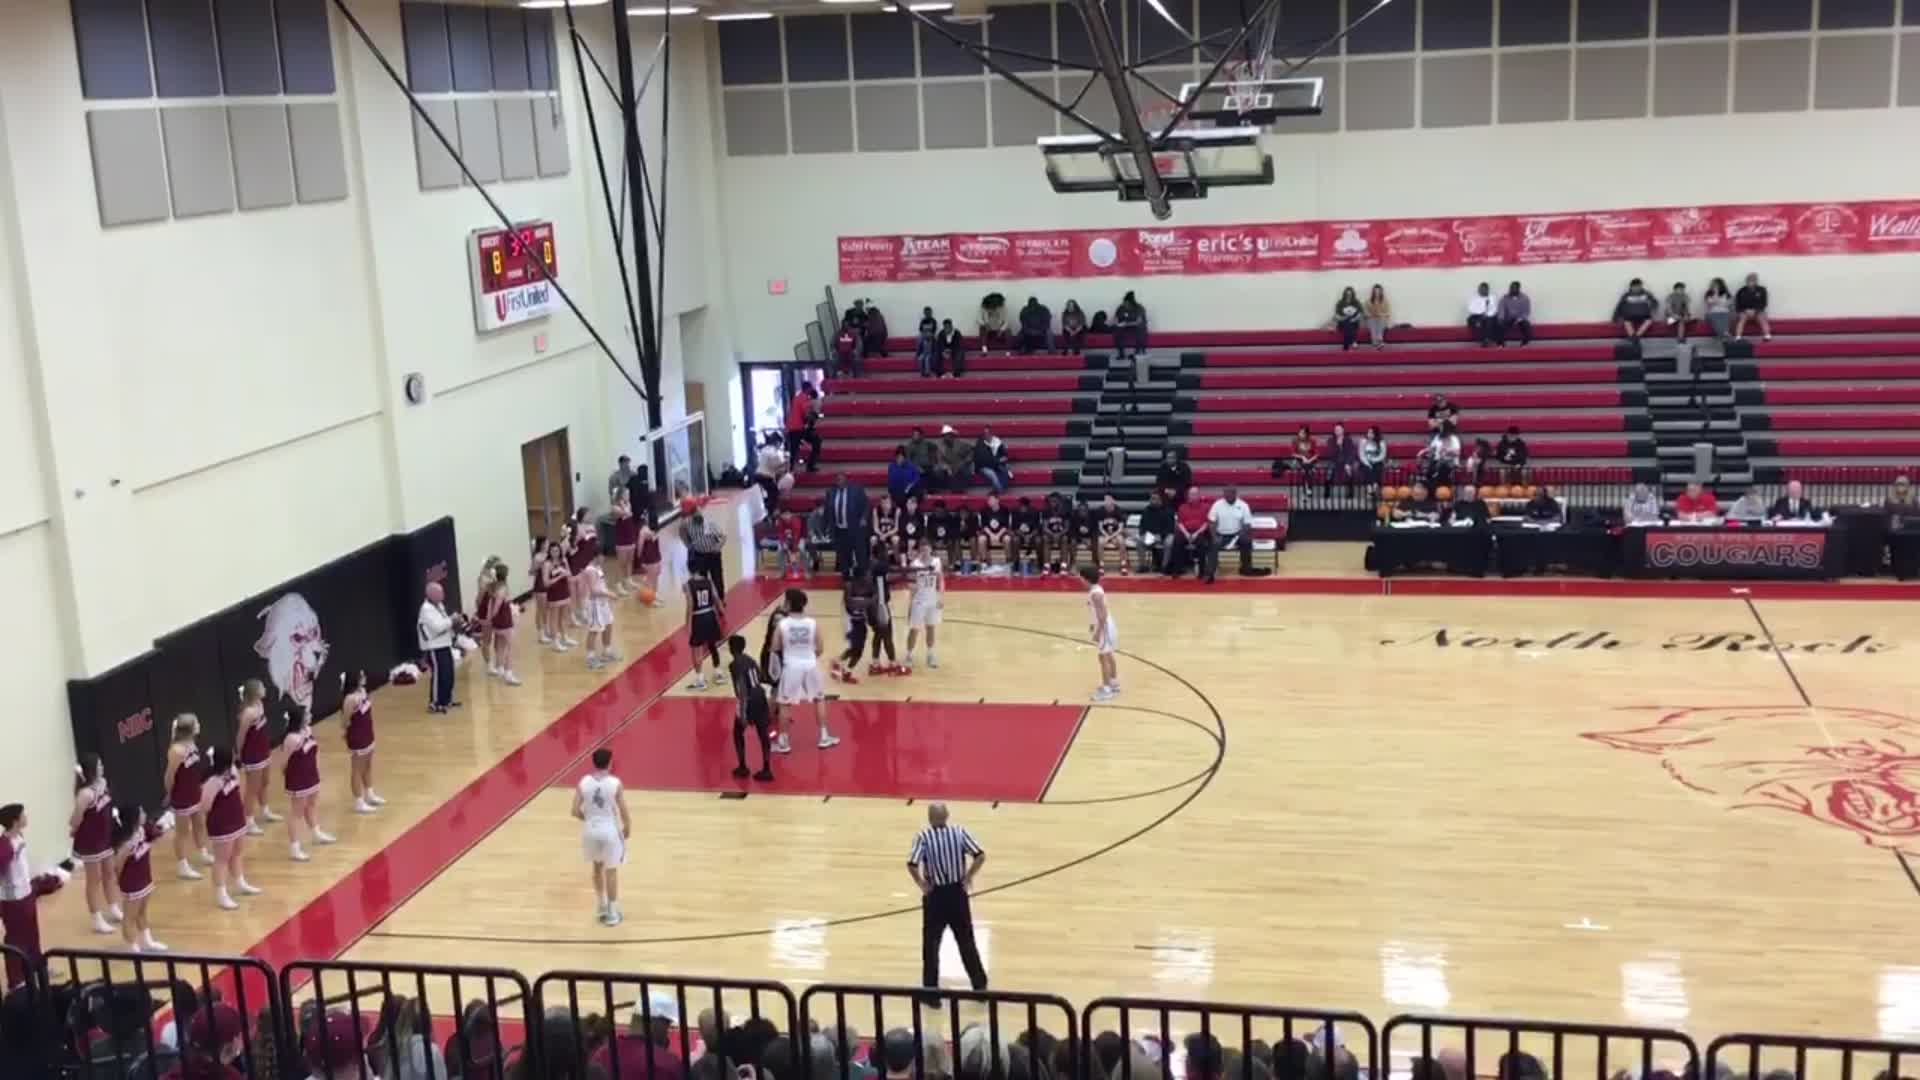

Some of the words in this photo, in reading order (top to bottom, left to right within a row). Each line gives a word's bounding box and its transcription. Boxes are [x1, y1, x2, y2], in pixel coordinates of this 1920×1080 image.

[1138, 230, 1174, 247] Pond
[1197, 232, 1253, 252] eric's
[1651, 542, 1820, 568] COUGARS
